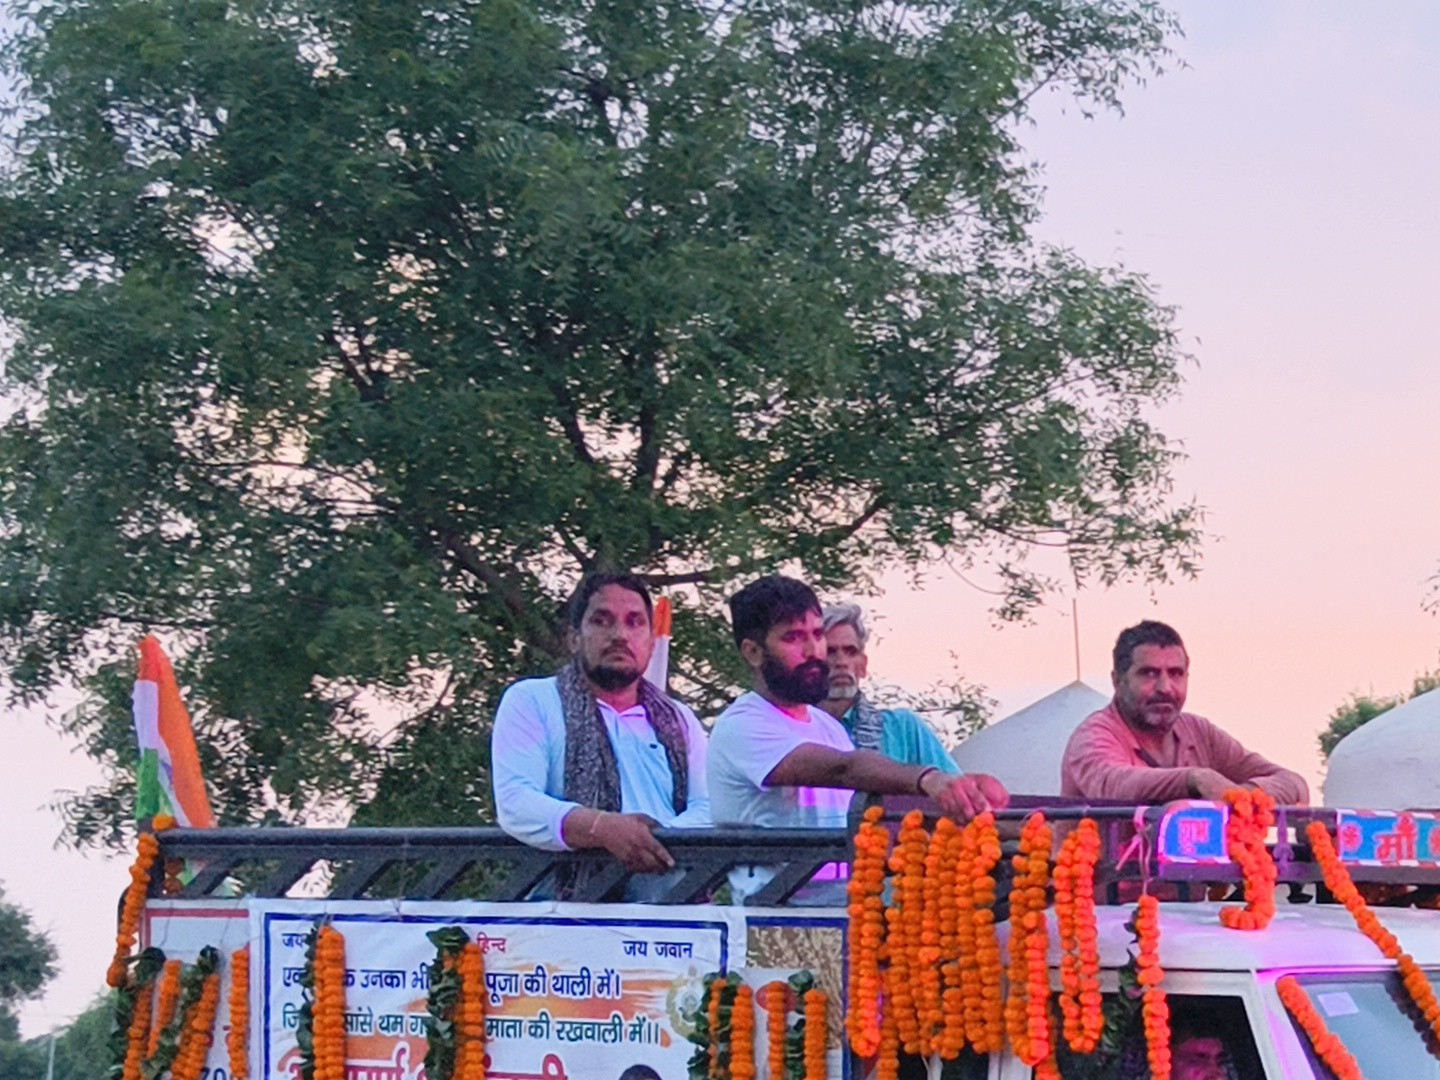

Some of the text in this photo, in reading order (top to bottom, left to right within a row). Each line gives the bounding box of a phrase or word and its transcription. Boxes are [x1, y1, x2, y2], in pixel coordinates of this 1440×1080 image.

[622, 940, 694, 959] जय जवान
[360, 968, 407, 990] उनका
[485, 971, 519, 1003] पूजा
[524, 965, 547, 994] की
[552, 966, 591, 997] थाली
[485, 1015, 523, 1040] माता
[528, 1010, 550, 1040] की
[555, 1012, 624, 1044] रखवाली
